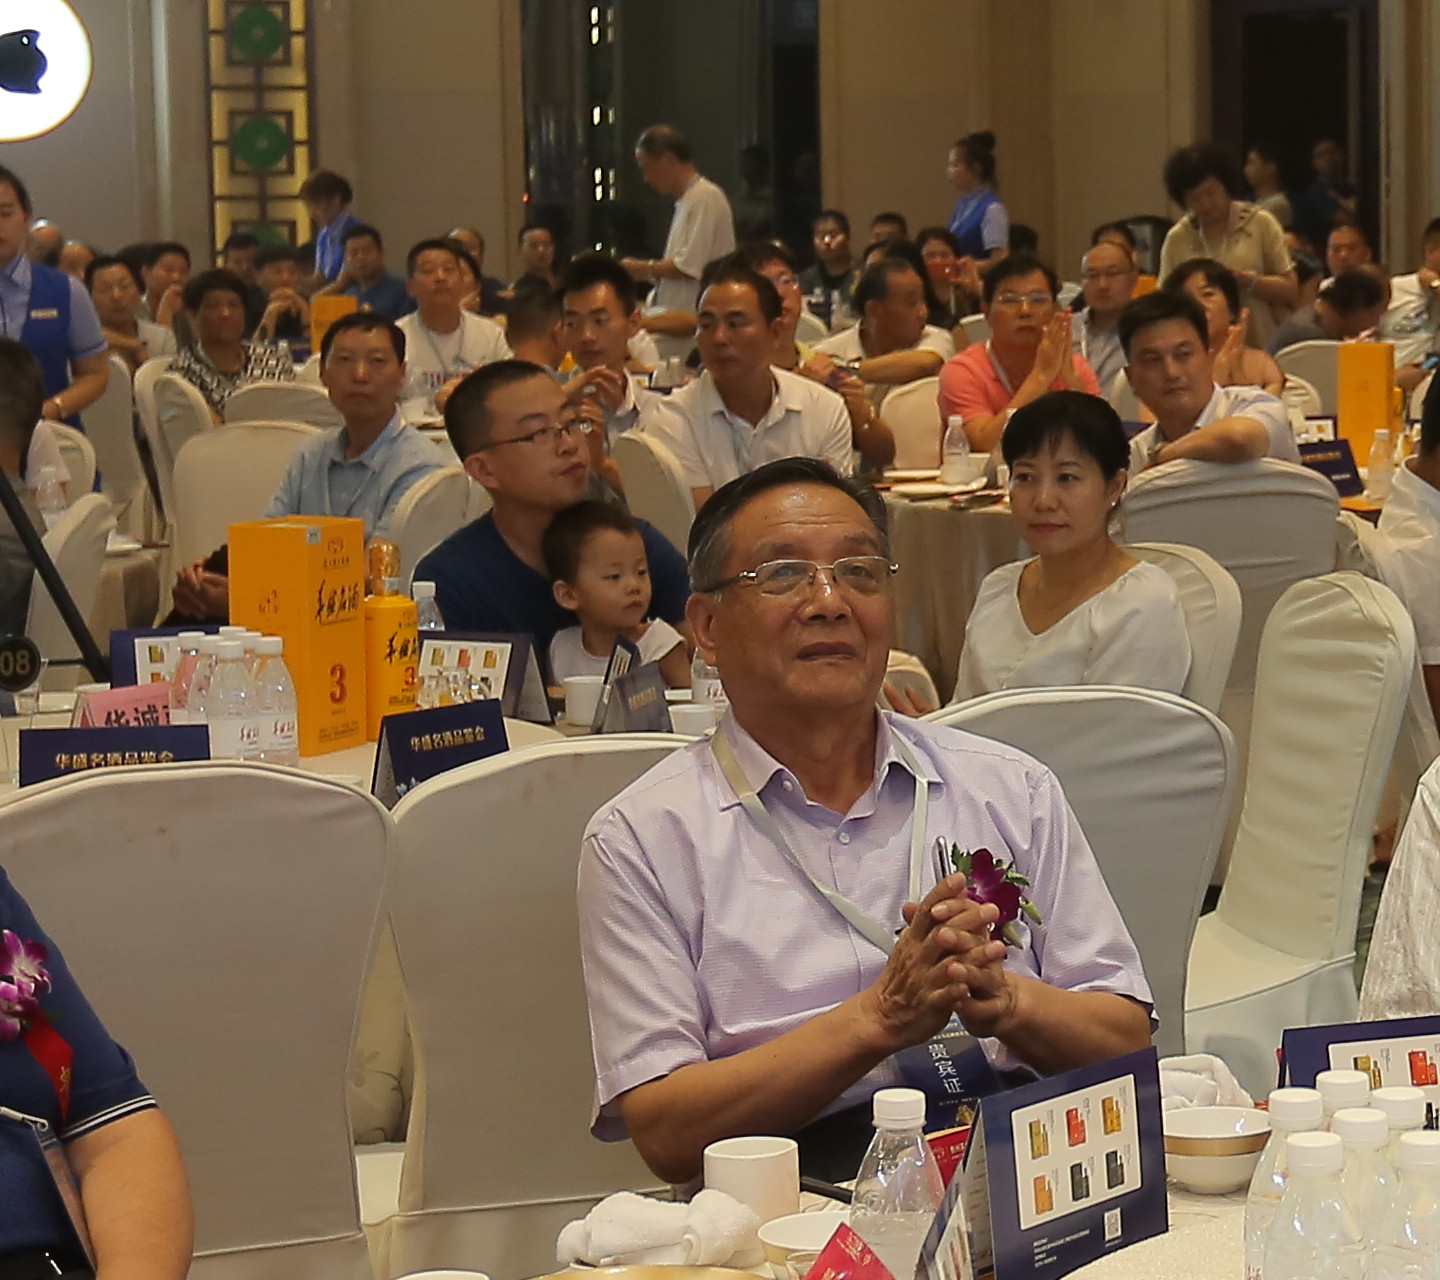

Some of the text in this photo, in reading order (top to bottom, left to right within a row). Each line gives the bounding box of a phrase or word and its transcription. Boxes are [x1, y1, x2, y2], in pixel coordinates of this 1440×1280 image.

[328, 663, 348, 705] 3
[404, 666, 420, 687] 3
[410, 725, 485, 753] 华盛名酒品鉴会
[928, 1043, 964, 1094] 贵宾证
